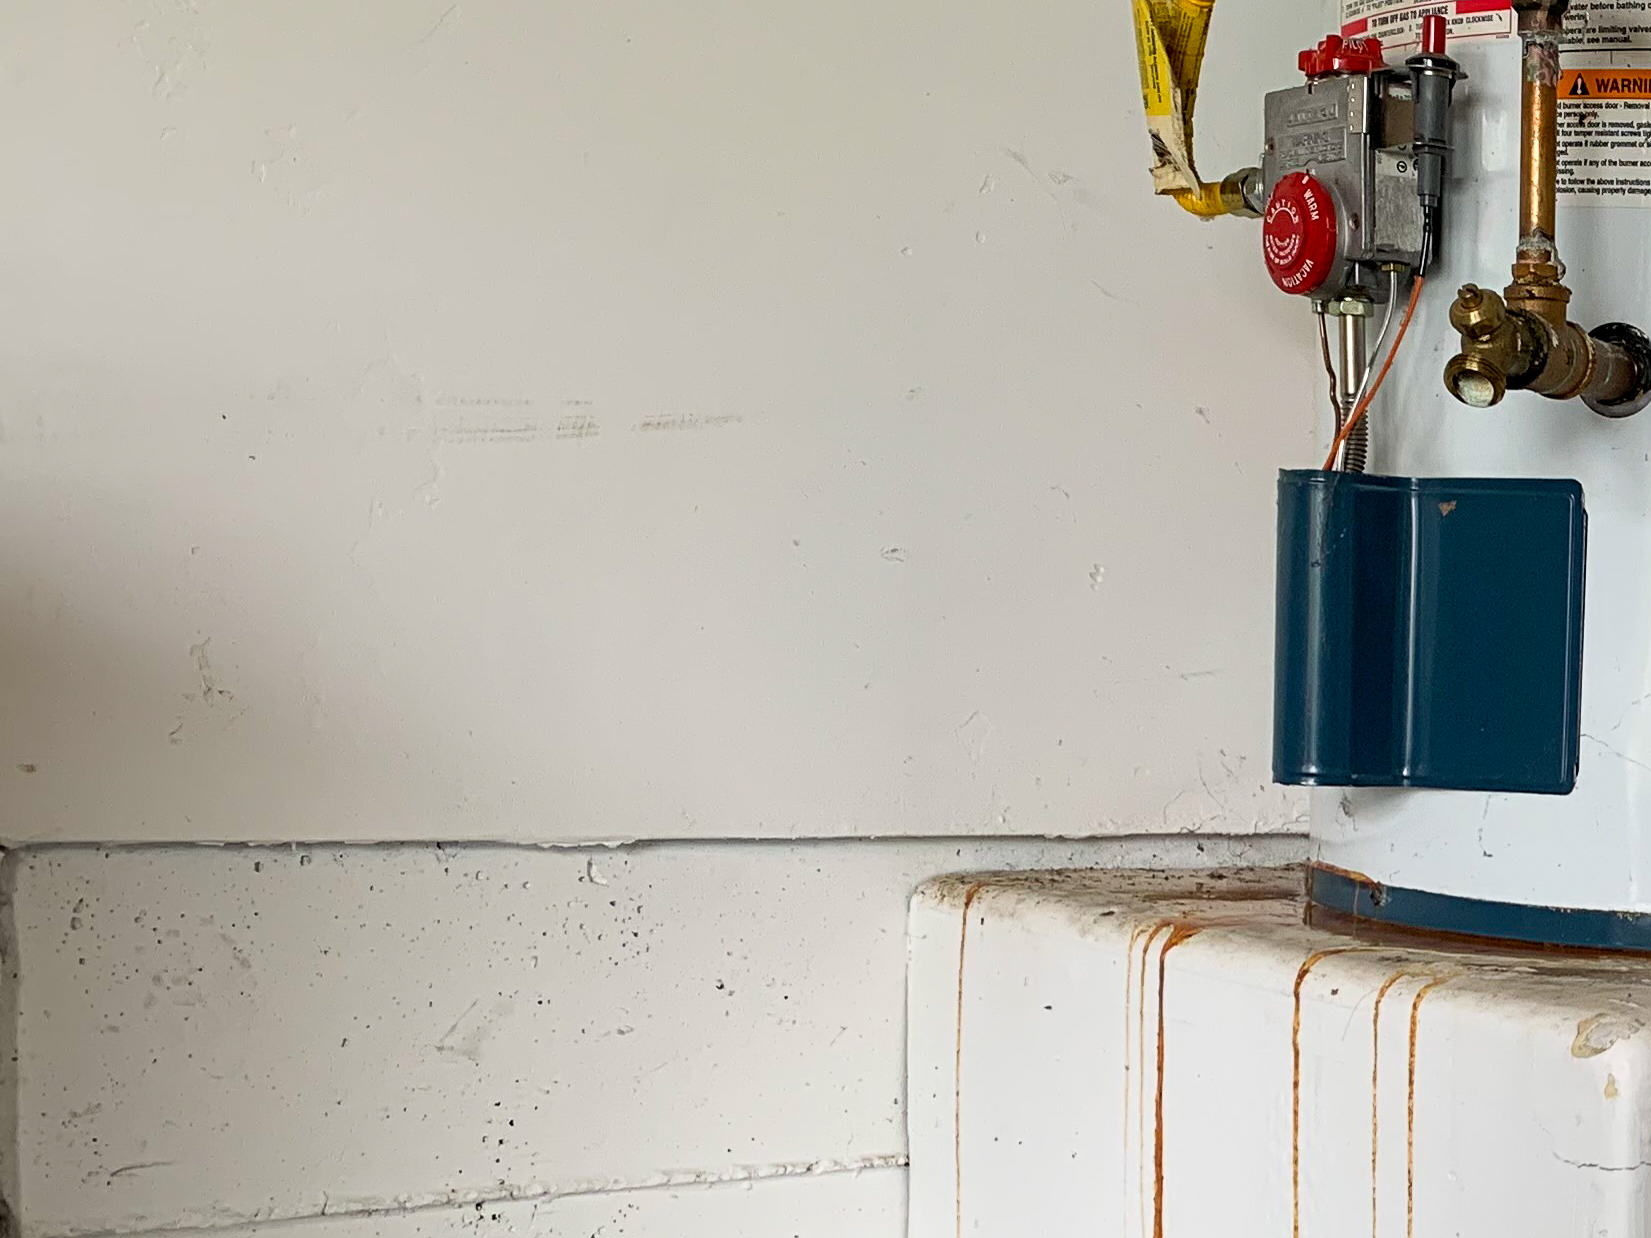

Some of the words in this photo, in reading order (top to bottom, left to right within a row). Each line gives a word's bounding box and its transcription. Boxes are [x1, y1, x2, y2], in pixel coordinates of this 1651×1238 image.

[1589, 2, 1614, 10] before
[1615, 1, 1645, 11] bathing
[1598, 25, 1626, 34] limiting
[1624, 102, 1650, 110] Removal
[1608, 121, 1635, 129] removed,
[1574, 130, 1593, 138] tamper
[1562, 141, 1583, 149] operate
[1610, 141, 1637, 149] grommet
[1608, 158, 1618, 166] the
[1619, 158, 1639, 167] burner
[1616, 178, 1651, 186] instructions
[1578, 187, 1600, 195] causing
[1602, 187, 1626, 196] property
[1303, 189, 1320, 221] WARM
[1281, 258, 1315, 288] VACATION
